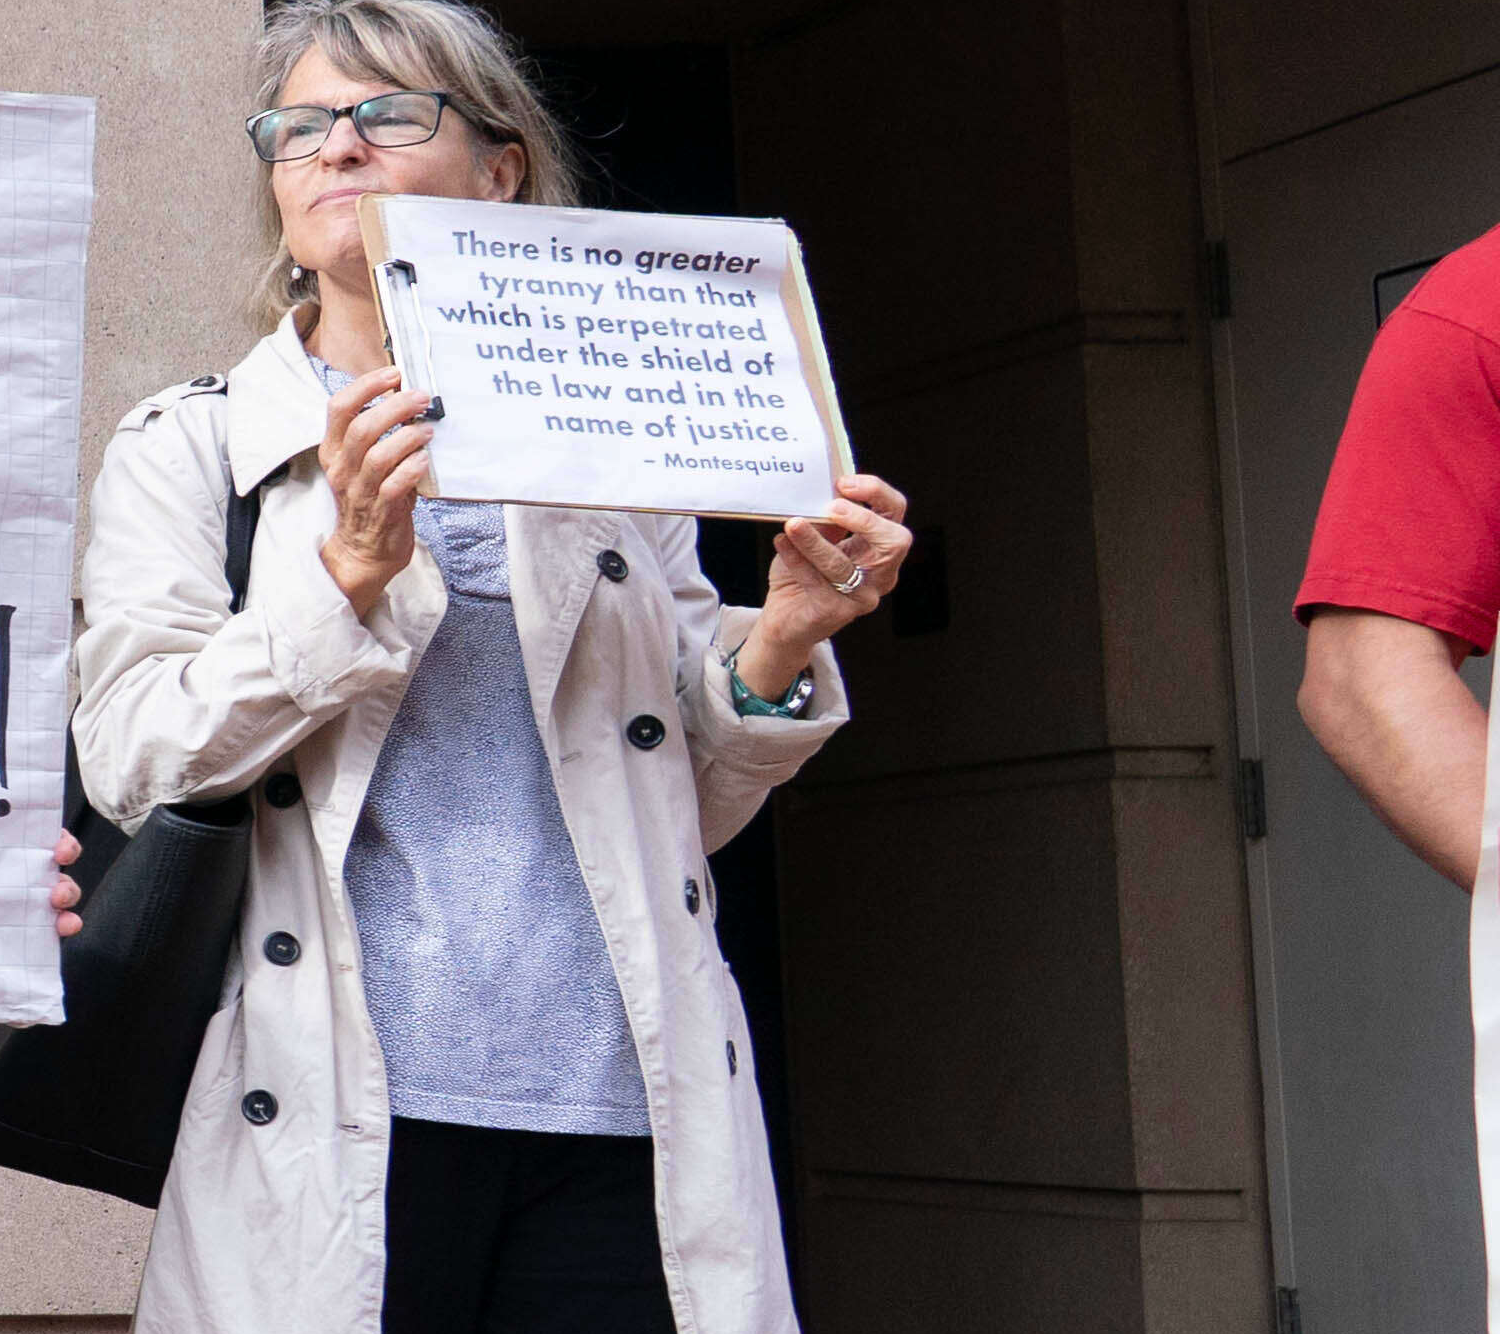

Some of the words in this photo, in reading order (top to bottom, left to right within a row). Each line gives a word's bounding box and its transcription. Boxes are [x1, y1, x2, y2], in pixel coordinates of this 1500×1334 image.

[451, 229, 540, 261] There
[550, 236, 574, 263] is
[583, 247, 624, 267] no
[634, 250, 761, 275] greater
[478, 271, 605, 306] tyranny
[614, 276, 687, 304] than
[695, 282, 757, 308] that
[436, 300, 533, 328] which
[540, 305, 566, 331] is
[575, 315, 768, 343] perpetrated
[475, 337, 569, 364] under
[578, 342, 629, 369] the
[640, 345, 734, 374] shield
[743, 351, 776, 376] of
[492, 370, 543, 397] the
[551, 373, 613, 401] law
[624, 380, 687, 405] and
[694, 382, 726, 407] in
[733, 384, 786, 409] the
[544, 414, 635, 437] name
[644, 414, 677, 438] of
[685, 415, 798, 446] justice.
[663, 452, 805, 476] Montesquieu
